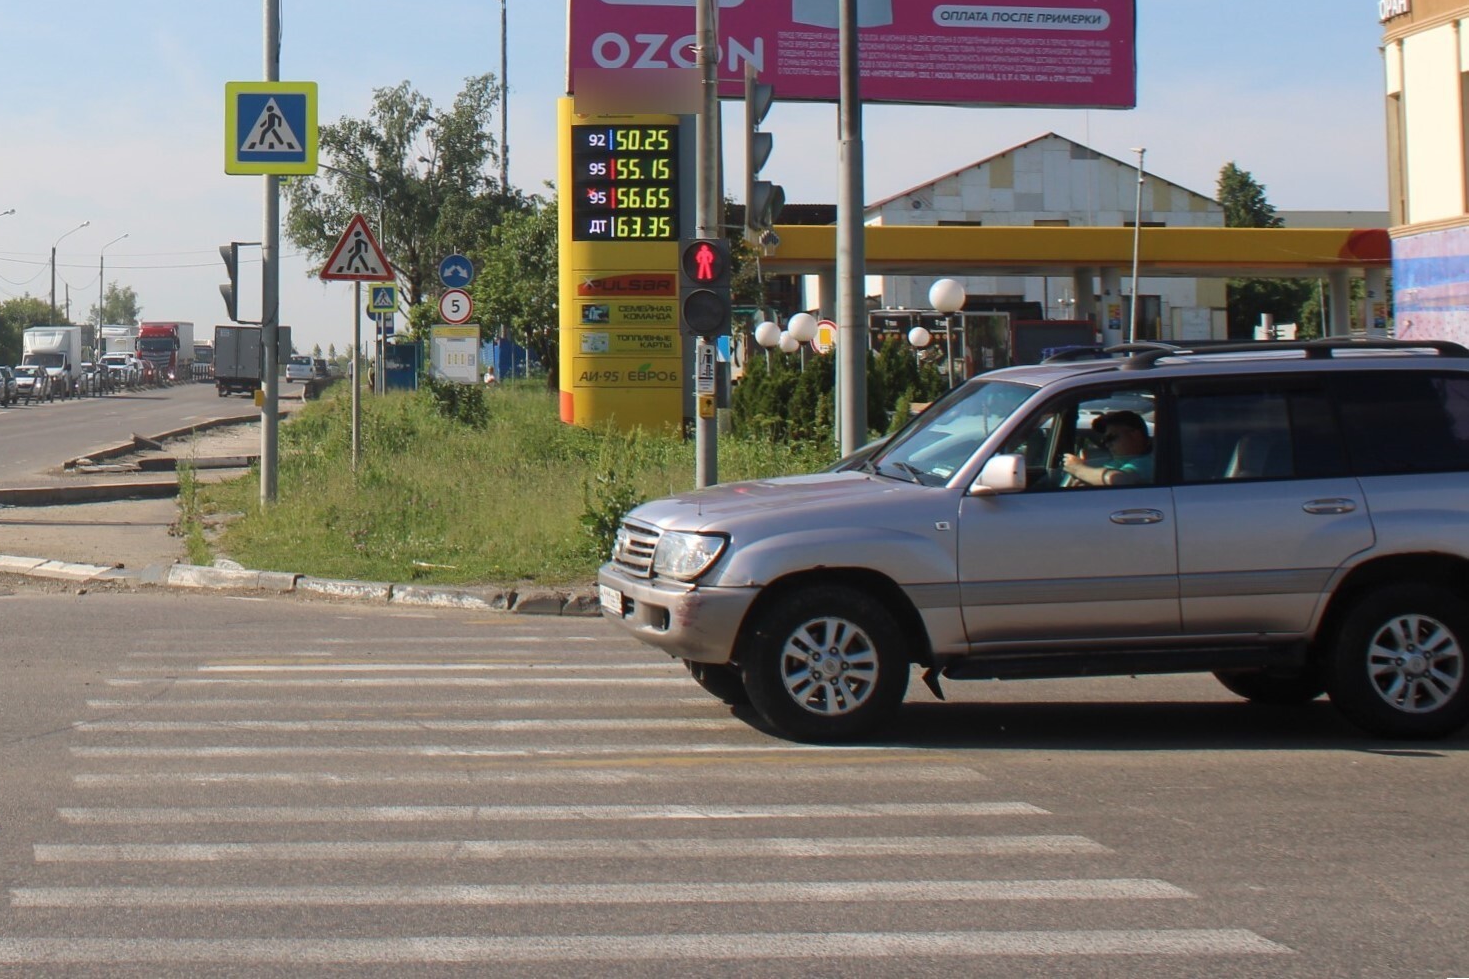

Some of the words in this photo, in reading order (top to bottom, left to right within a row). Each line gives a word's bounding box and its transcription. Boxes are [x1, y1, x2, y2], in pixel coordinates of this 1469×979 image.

[940, 10, 988, 21] ОПЛАТА
[991, 12, 1034, 23] ПОСЛЕ
[1036, 13, 1102, 24] ПРИМЕРКИ
[589, 134, 606, 146] 92
[616, 129, 670, 150] 50.25
[589, 163, 606, 175] 95
[616, 158, 670, 179] 55.15
[589, 192, 607, 204] 95
[617, 188, 670, 209] 56.65
[589, 220, 607, 234] ДТ
[617, 217, 670, 237] 63.35
[451, 299, 460, 313] 5
[618, 304, 672, 312] СЕМЕЙНАЯ
[623, 312, 672, 321] КОМАНДА
[617, 334, 671, 342] ТОПЛИВНЫЕ
[640, 341, 672, 349] КАРТЫ
